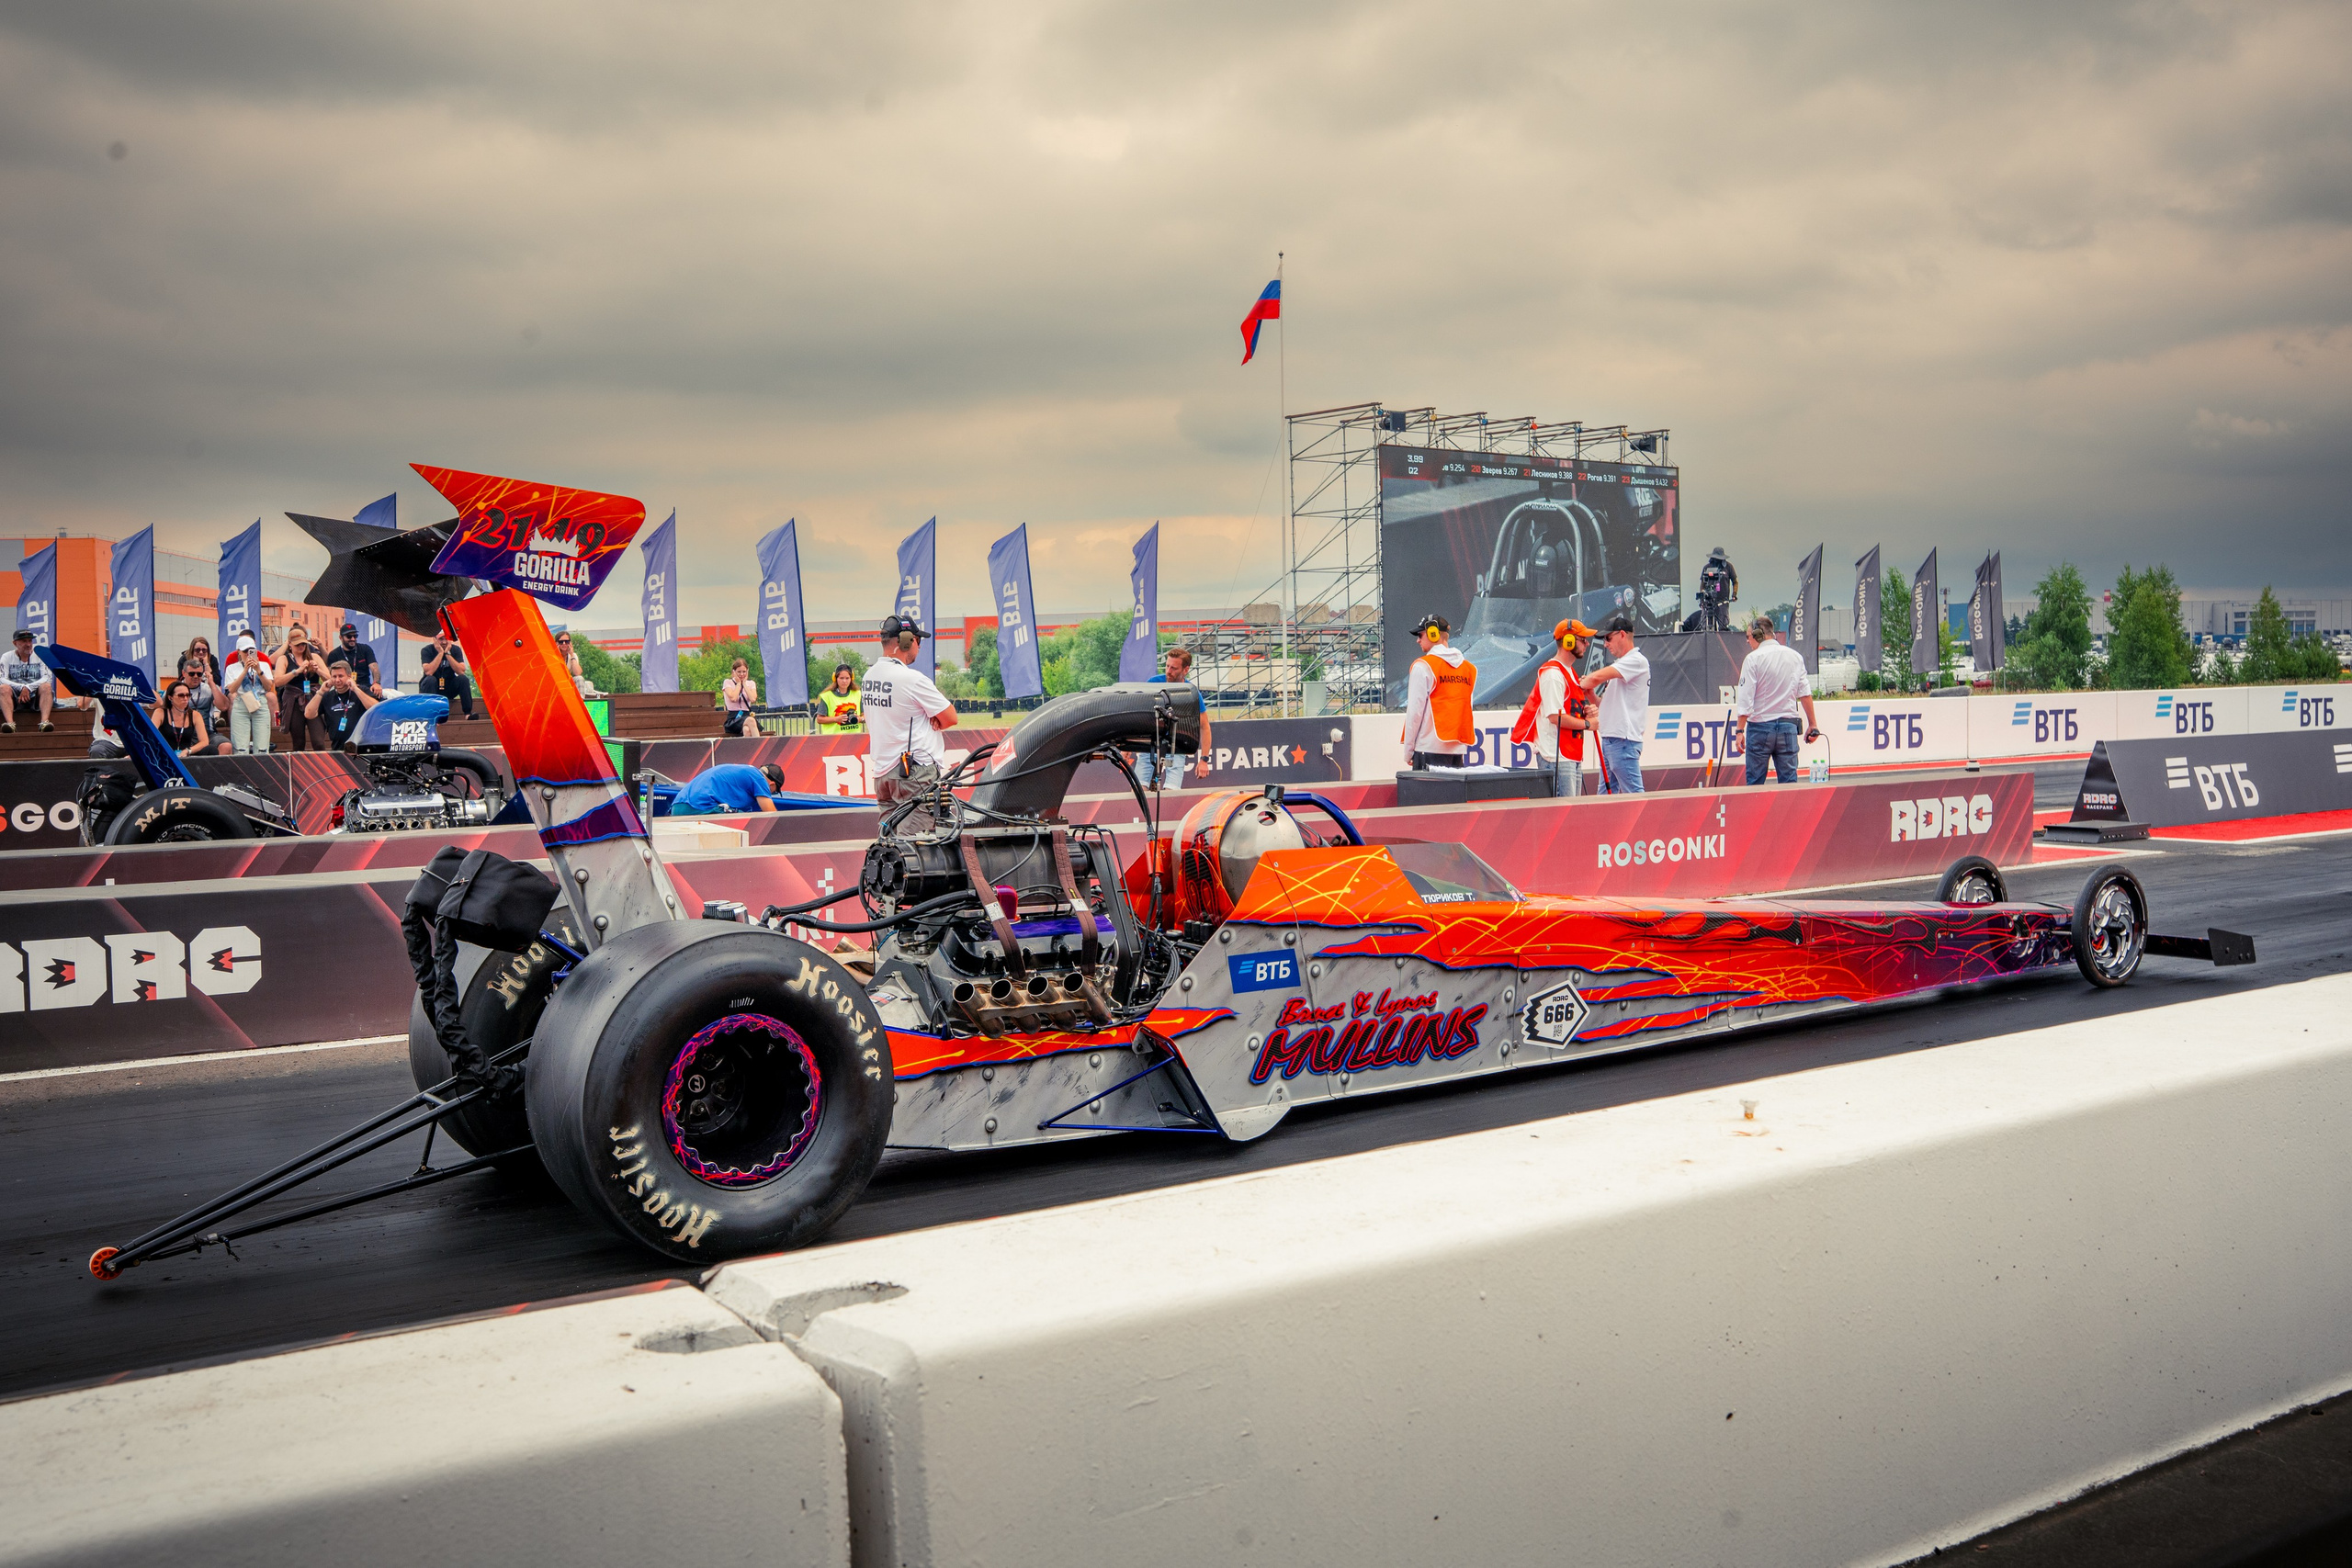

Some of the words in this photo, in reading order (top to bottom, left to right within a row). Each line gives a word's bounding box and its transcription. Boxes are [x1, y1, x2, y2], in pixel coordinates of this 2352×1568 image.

[1449, 463, 1465, 472] 9.254
[1502, 467, 1518, 476] 9.267
[1523, 468, 1531, 477] 21
[1577, 472, 1587, 480] 22
[1602, 474, 1617, 483] 9.391
[1622, 476, 1631, 484] 23
[1655, 478, 1668, 487] 9.432
[514, 552, 591, 586] GORILLA
[522, 581, 554, 593] ENERGY
[554, 584, 580, 596] DRINK
[103, 683, 138, 697] GORILLA
[862, 680, 893, 694] DRC
[862, 694, 892, 707] fficial
[2300, 697, 2335, 727] ВТБ
[391, 721, 428, 734] MAX
[2035, 708, 2078, 743] ВТБ
[2176, 702, 2214, 734] ВТБ
[1873, 714, 1923, 750] ВТБ
[390, 743, 425, 751] MOTORSPORT
[2193, 762, 2259, 811] ВТБ
[2083, 793, 2118, 805] RDRC
[174, 823, 211, 834] RACING
[1890, 794, 1993, 842] RDRC
[1598, 834, 1725, 868] ROSGONKI
[1421, 893, 1465, 904] ТЮРИКОВ
[1255, 959, 1291, 982] ВТБ
[785, 956, 882, 1081] Hoosier
[1544, 1002, 1575, 1024] 666
[1250, 1003, 1488, 1085] MULLINS
